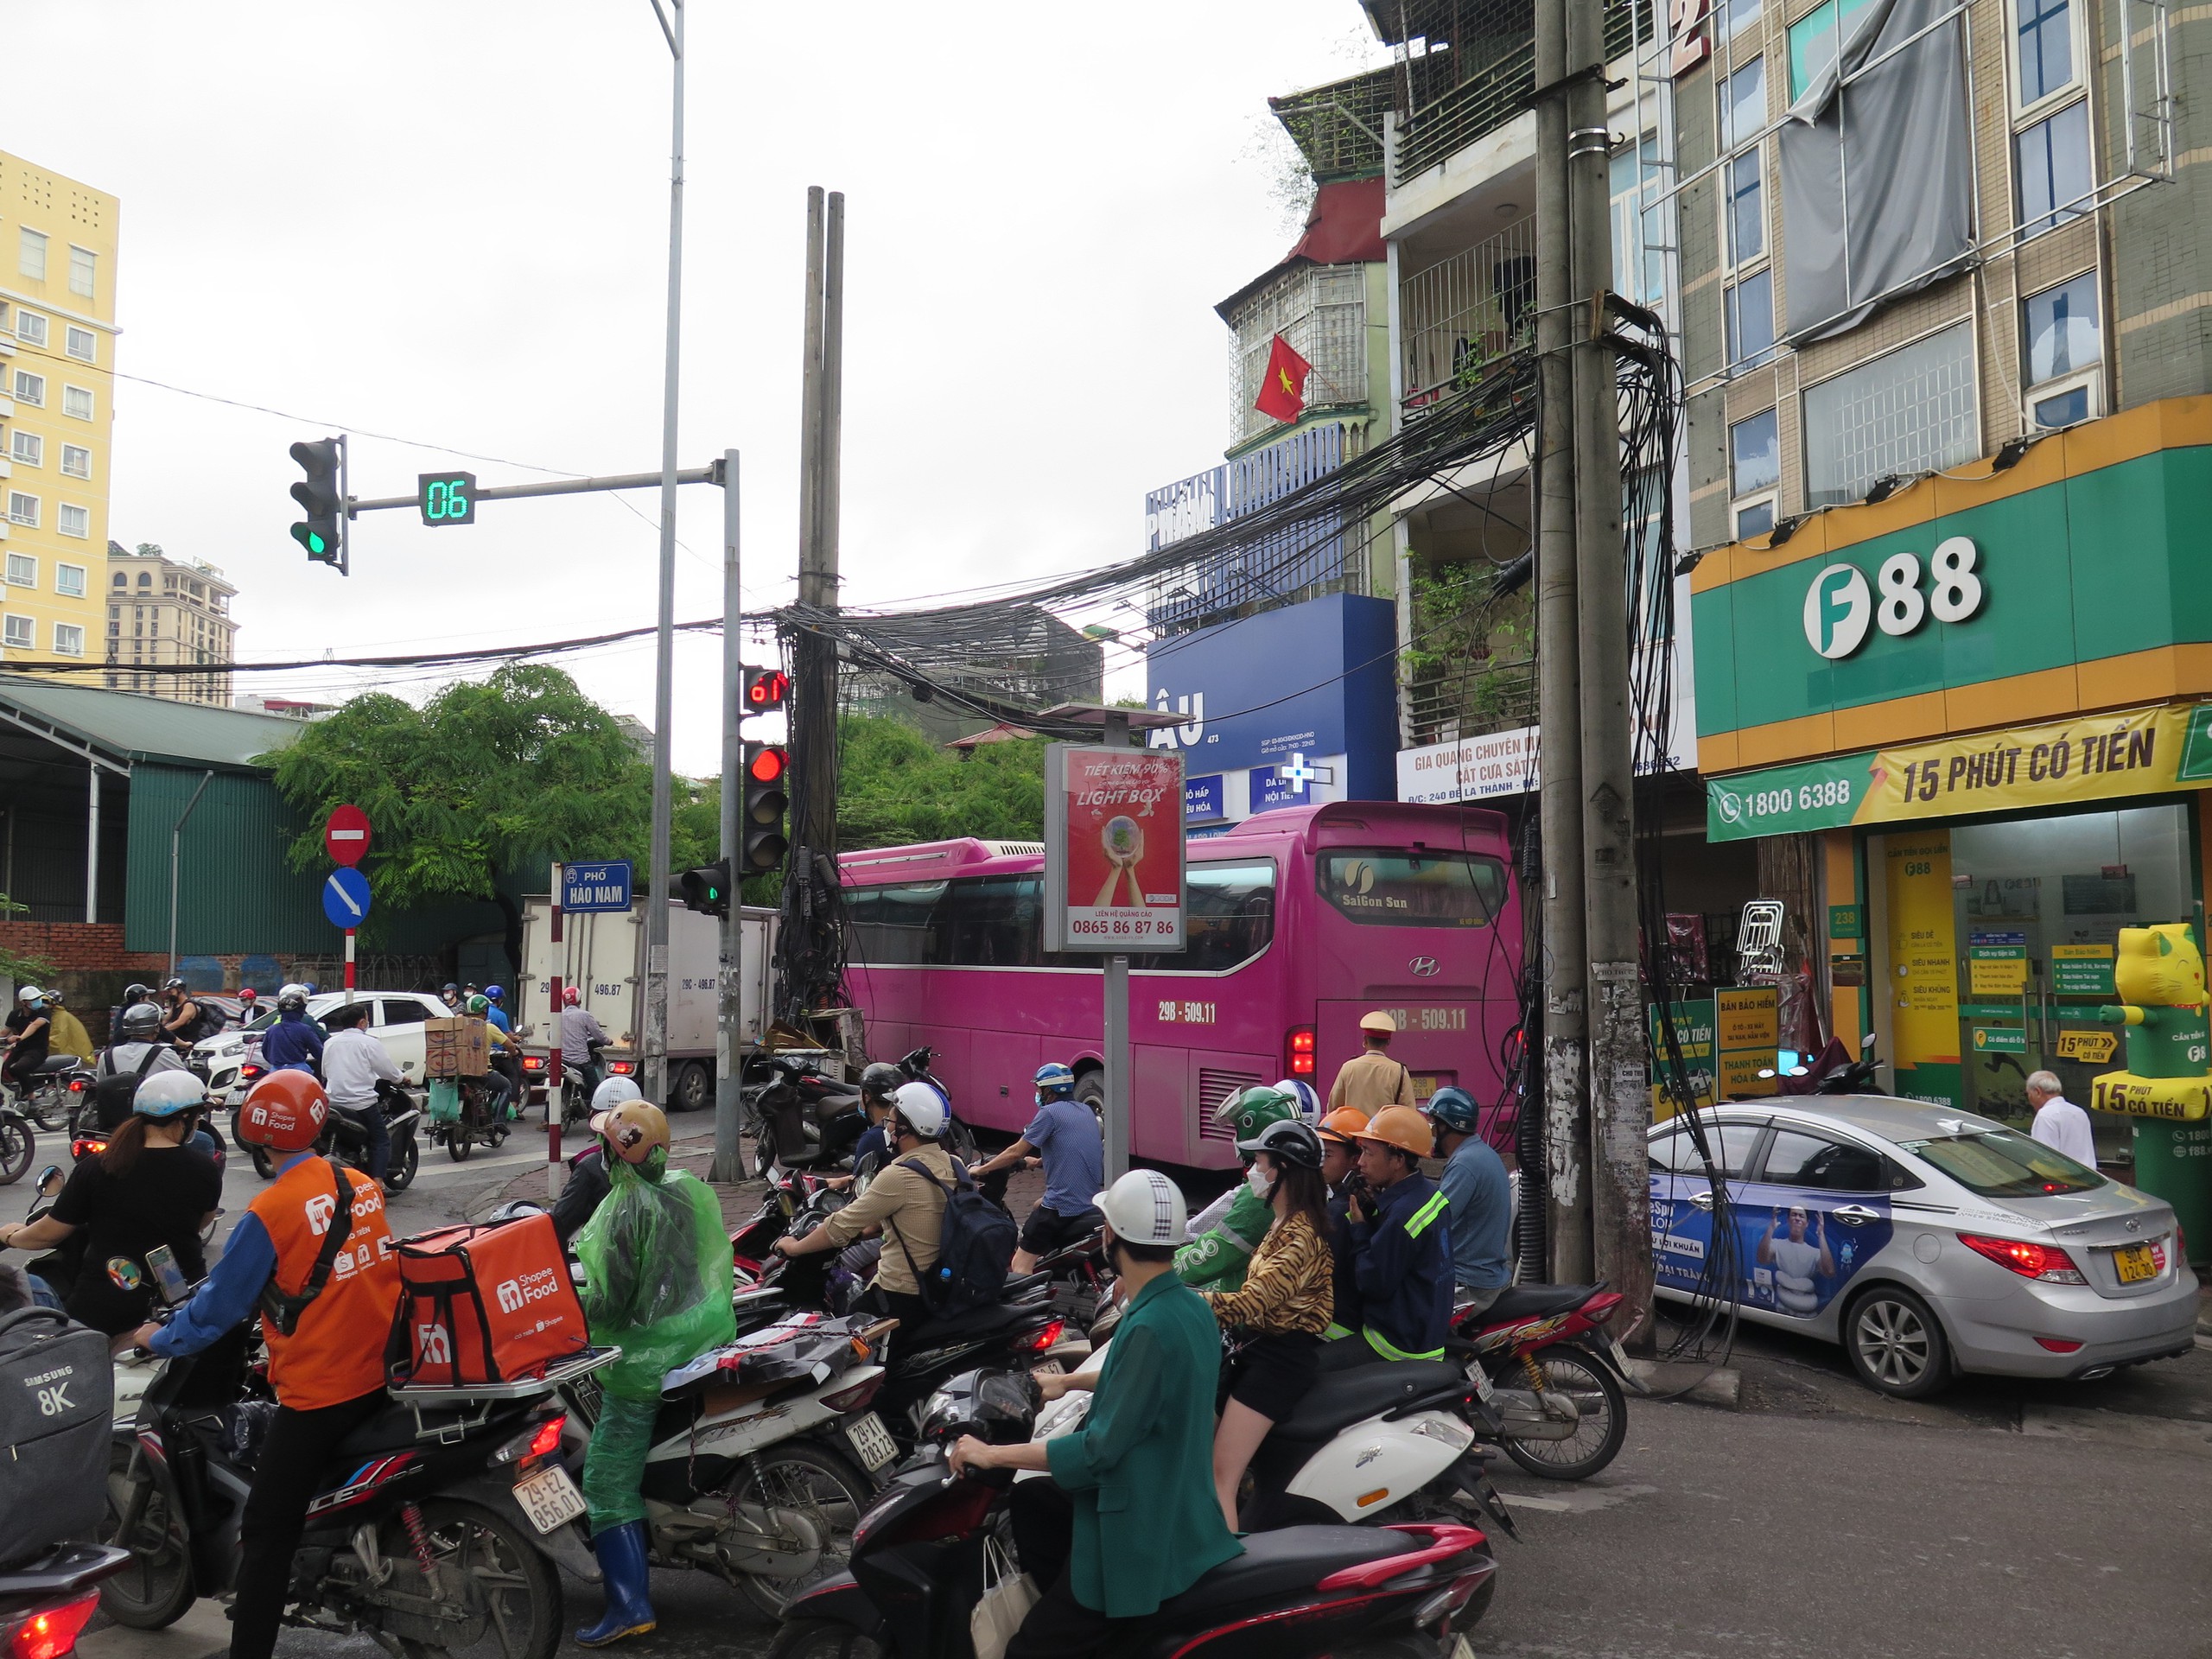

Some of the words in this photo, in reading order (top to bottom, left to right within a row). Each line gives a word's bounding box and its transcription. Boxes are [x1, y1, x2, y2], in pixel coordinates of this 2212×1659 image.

[426, 480, 468, 519] 06
[1802, 536, 1982, 659] F88
[1149, 688, 1204, 750] ÂU
[1207, 734, 1219, 744] 473
[1414, 754, 1432, 771] GIA
[1435, 748, 1473, 766] QUANG
[1475, 737, 1520, 760] CHUYÊN
[1903, 760, 1940, 804] 15
[1948, 741, 2021, 793] PHÚT
[2028, 733, 2069, 783] CÓ
[2082, 717, 2156, 774] TIỀN
[1084, 760, 1110, 777] TIẾT
[1110, 761, 1141, 778] KIỆM
[1143, 762, 1169, 775] 90%
[1455, 762, 1478, 785] CẮT
[1480, 762, 1503, 780] CƯA
[1506, 756, 1527, 777] SẮT
[1265, 779, 1277, 787] DA
[1076, 788, 1128, 806] LIGHT
[1128, 787, 1166, 804] BOX
[1195, 788, 1210, 798] HẤP
[1264, 790, 1278, 804] NỘI
[1408, 791, 1427, 804] Đ/C:
[1429, 791, 1446, 802] 240
[1465, 786, 1477, 798] LA
[1478, 779, 1513, 795] THÀNH
[1745, 788, 1793, 818] 1800
[1798, 779, 1851, 810] 6388
[1195, 802, 1211, 813] HÓA
[584, 867, 607, 881] PHỐ
[1905, 861, 1931, 877] F88
[569, 883, 592, 905] HÀO
[594, 885, 623, 904] NAM
[1342, 894, 1382, 907] SaiGon
[1385, 896, 1408, 909] Sun
[1095, 909, 1109, 918] LIÊN
[1109, 910, 1118, 918] HỆ
[1119, 910, 1140, 918] QUẢNG
[1835, 912, 1856, 925] 238
[1072, 920, 1109, 934] 0865
[1113, 920, 1130, 934] 86
[1135, 921, 1152, 934] 87
[1156, 921, 1173, 934] 86
[1910, 931, 1925, 940] SIÊU
[1911, 957, 1926, 967] SIÊU
[540, 982, 551, 994] 29
[594, 983, 622, 996] 496.87
[698, 978, 715, 990] 496.87
[1913, 985, 1927, 994] SIÊU
[1928, 984, 1951, 994] KHỦNG
[1720, 1001, 1737, 1012] BÁN
[1738, 998, 1755, 1010] BẢO
[1757, 995, 1776, 1008] HIỂM
[1158, 1001, 1176, 1022] 29B
[1185, 1001, 1216, 1025] 509.11
[1421, 1008, 1466, 1030] 509.11
[2060, 1037, 2076, 1052] 15
[2077, 1035, 2099, 1047] PHÚT
[2082, 1050, 2091, 1059] CÓ
[2092, 1050, 2105, 1059] TIỀN
[1724, 1060, 1751, 1071] THANH
[1752, 1058, 1774, 1068] TOÁN
[1731, 1073, 1748, 1084] HÓA
[1933, 1096, 1952, 1106] 6388
[2094, 1082, 2128, 1111] 15
[2129, 1084, 2153, 1096] PHÚT
[2127, 1097, 2147, 1114] CÓ
[2151, 1096, 2185, 1118] TIỀN
[270, 1111, 296, 1122] Shopee
[268, 1119, 296, 1132] Food
[1649, 1200, 1675, 1217] eSpo
[1650, 1216, 1673, 1230] LON
[1986, 1215, 2029, 1228] STANDARD
[1673, 1239, 1700, 1255] KHUẨN
[335, 1269, 359, 1282] Shopee
[518, 1267, 554, 1287] Shopee
[1657, 1264, 1675, 1277] ĐẠI
[522, 1275, 559, 1305] Food
[543, 1315, 564, 1328] Shopee
[24, 1364, 73, 1388] SAMSUNG
[37, 1381, 76, 1417] 8K
[862, 1433, 895, 1468] 283.23
[533, 1489, 583, 1529] 856.01
